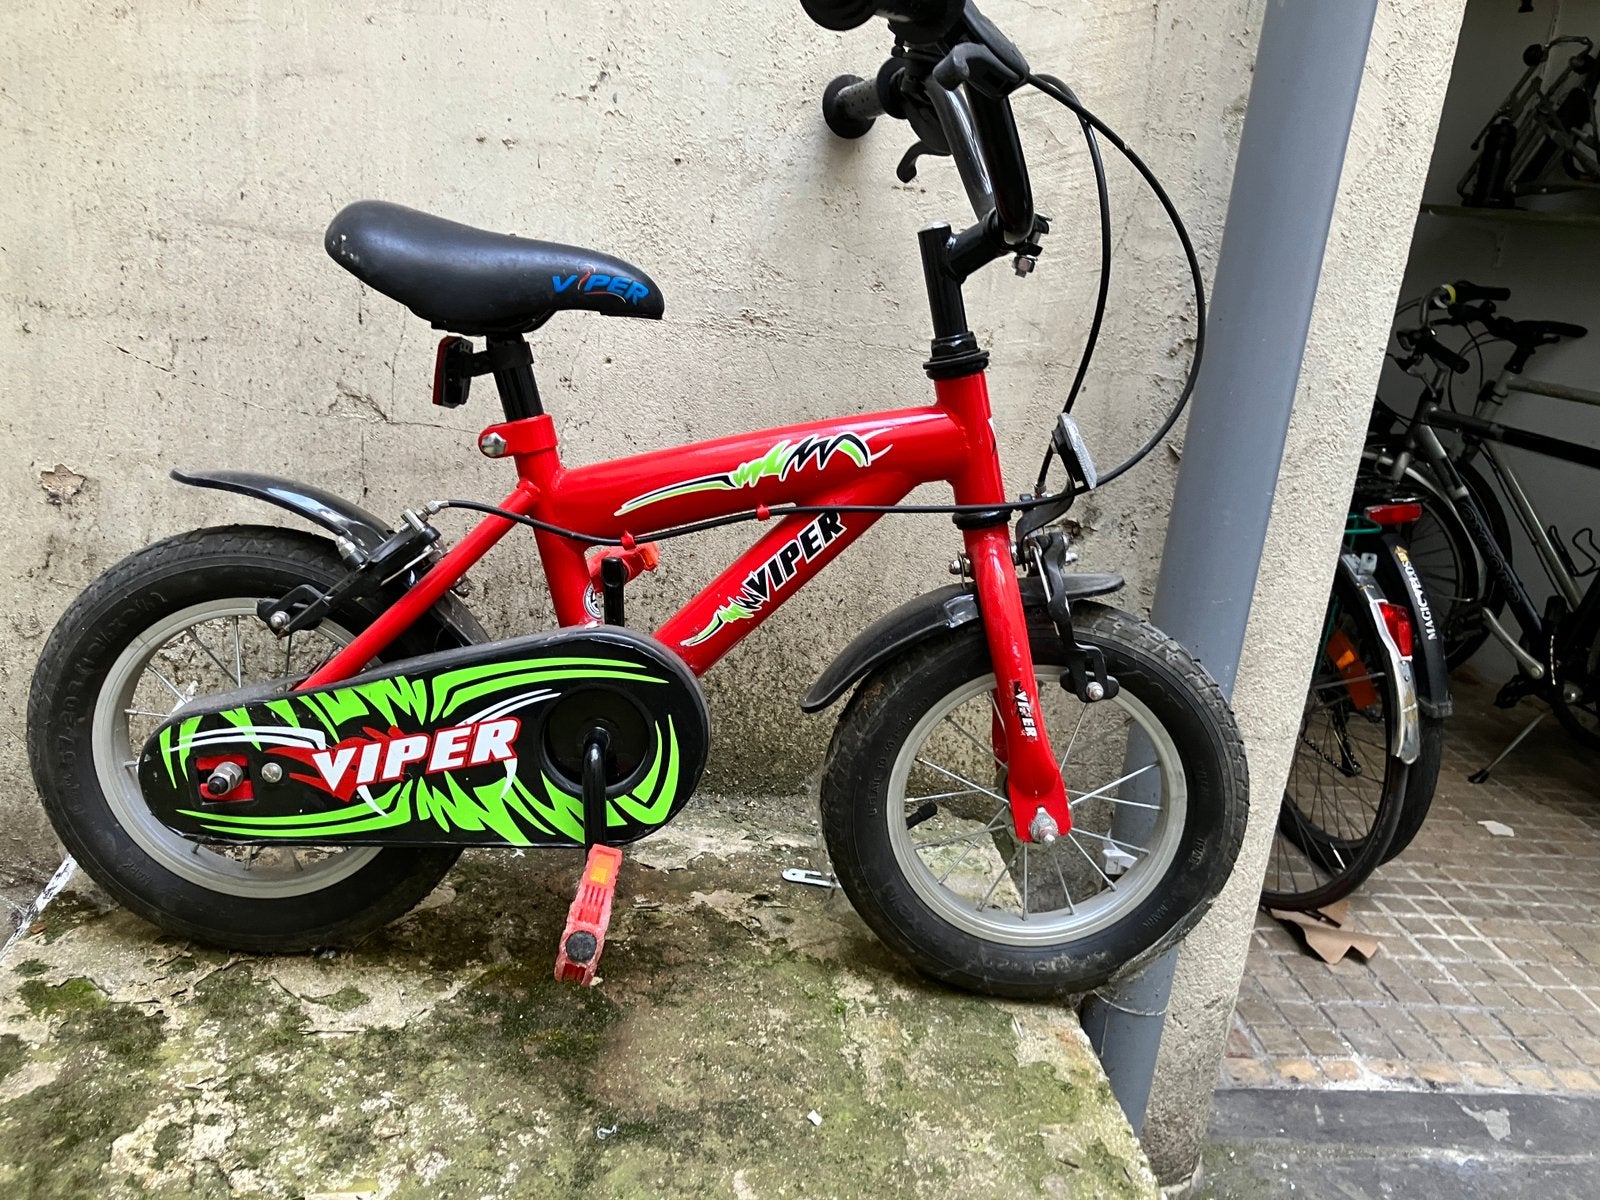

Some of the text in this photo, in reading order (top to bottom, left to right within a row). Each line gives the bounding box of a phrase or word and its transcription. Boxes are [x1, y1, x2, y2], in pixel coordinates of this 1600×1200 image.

[552, 264, 649, 305] VIPER
[742, 511, 847, 601] VIPER
[311, 717, 521, 793] VIPER
